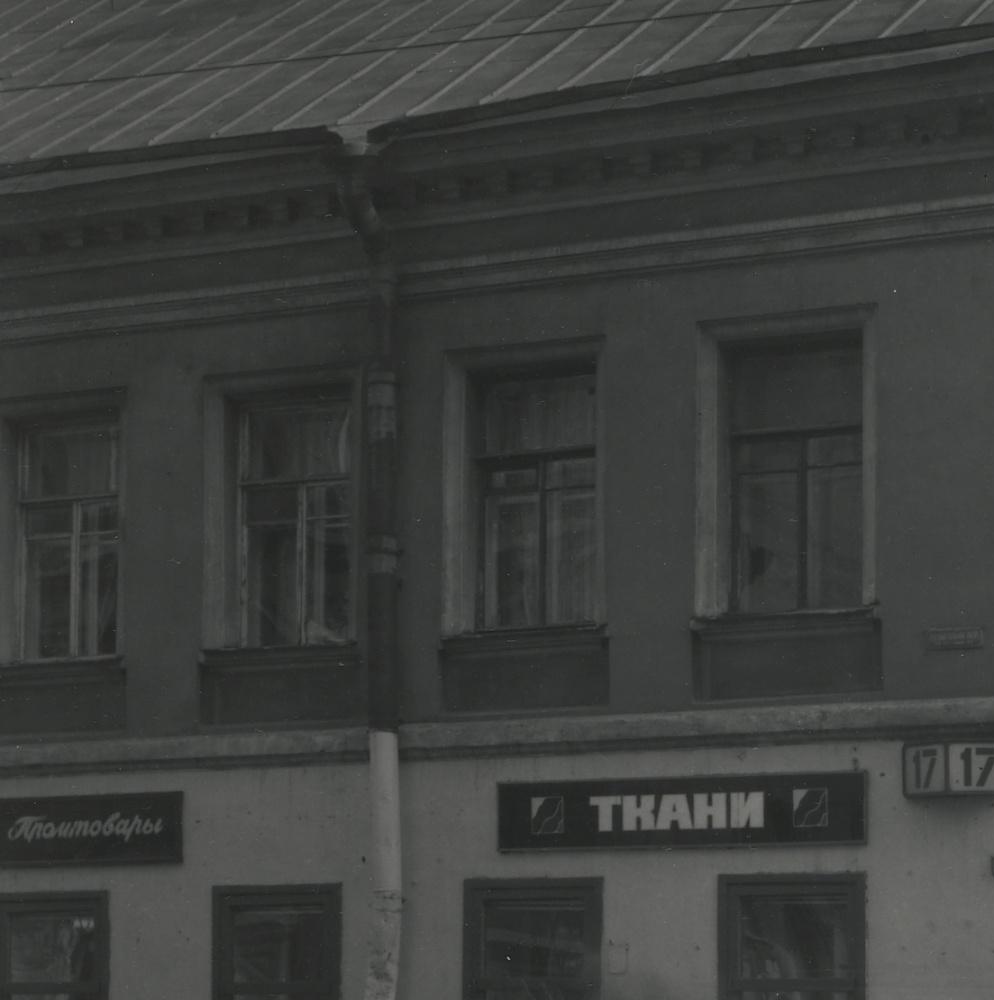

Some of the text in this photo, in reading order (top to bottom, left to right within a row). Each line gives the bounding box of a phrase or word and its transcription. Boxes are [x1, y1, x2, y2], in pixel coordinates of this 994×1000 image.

[913, 749, 937, 788] 17
[8, 812, 163, 843] Промтовары
[590, 791, 765, 832] ТКАНИ
